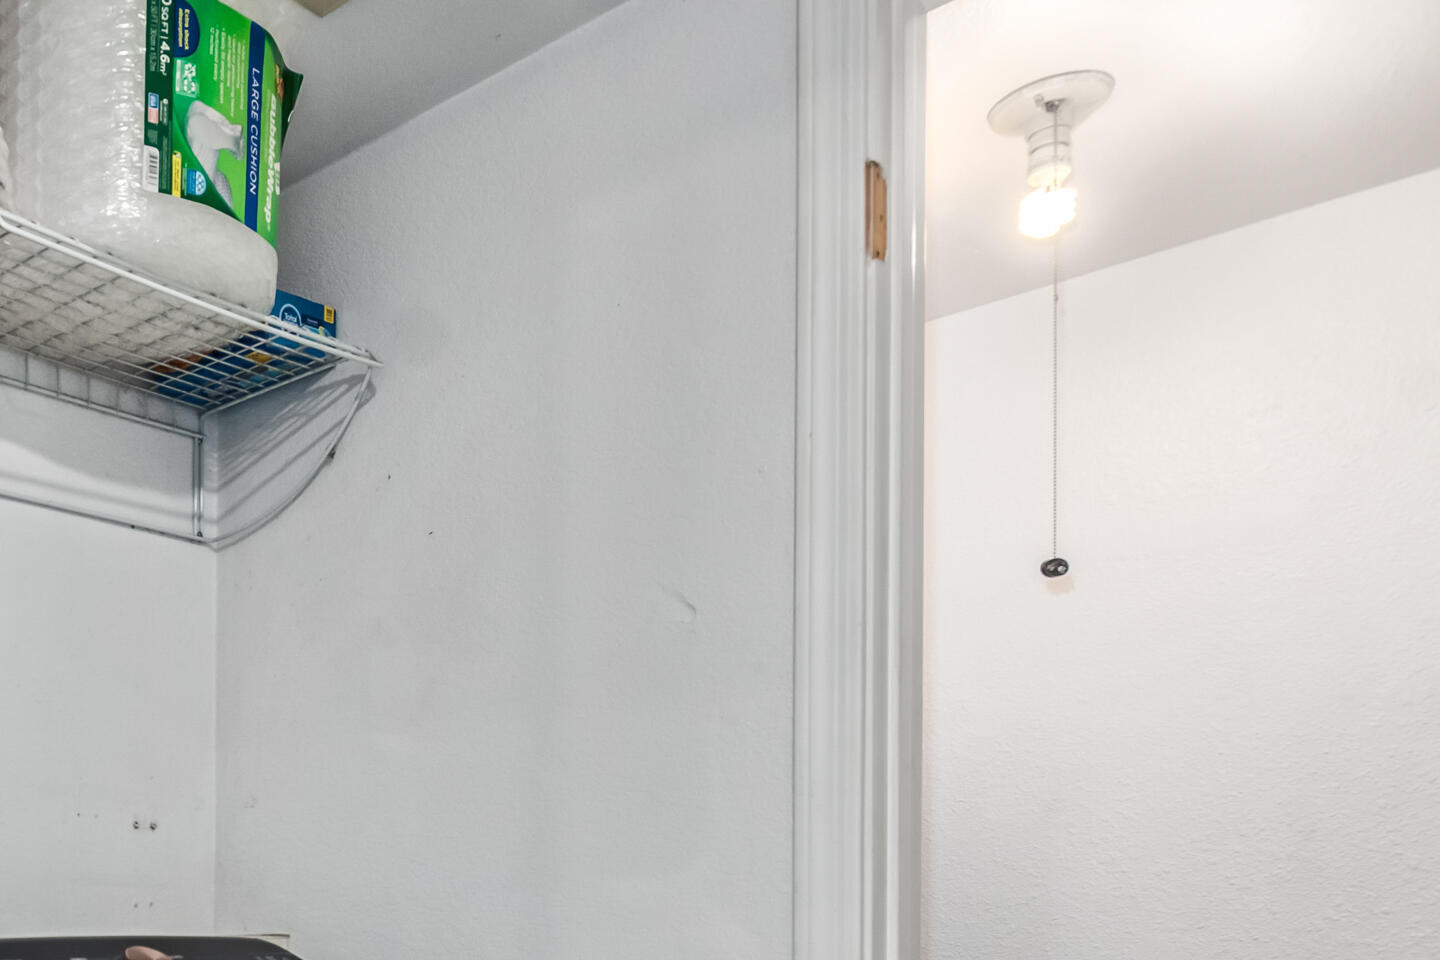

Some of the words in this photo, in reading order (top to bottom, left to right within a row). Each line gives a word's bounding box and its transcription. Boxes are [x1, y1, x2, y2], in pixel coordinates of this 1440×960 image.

[161, 21, 170, 35] FT
[250, 67, 260, 120] LARGE
[249, 125, 259, 195] CUSHION
